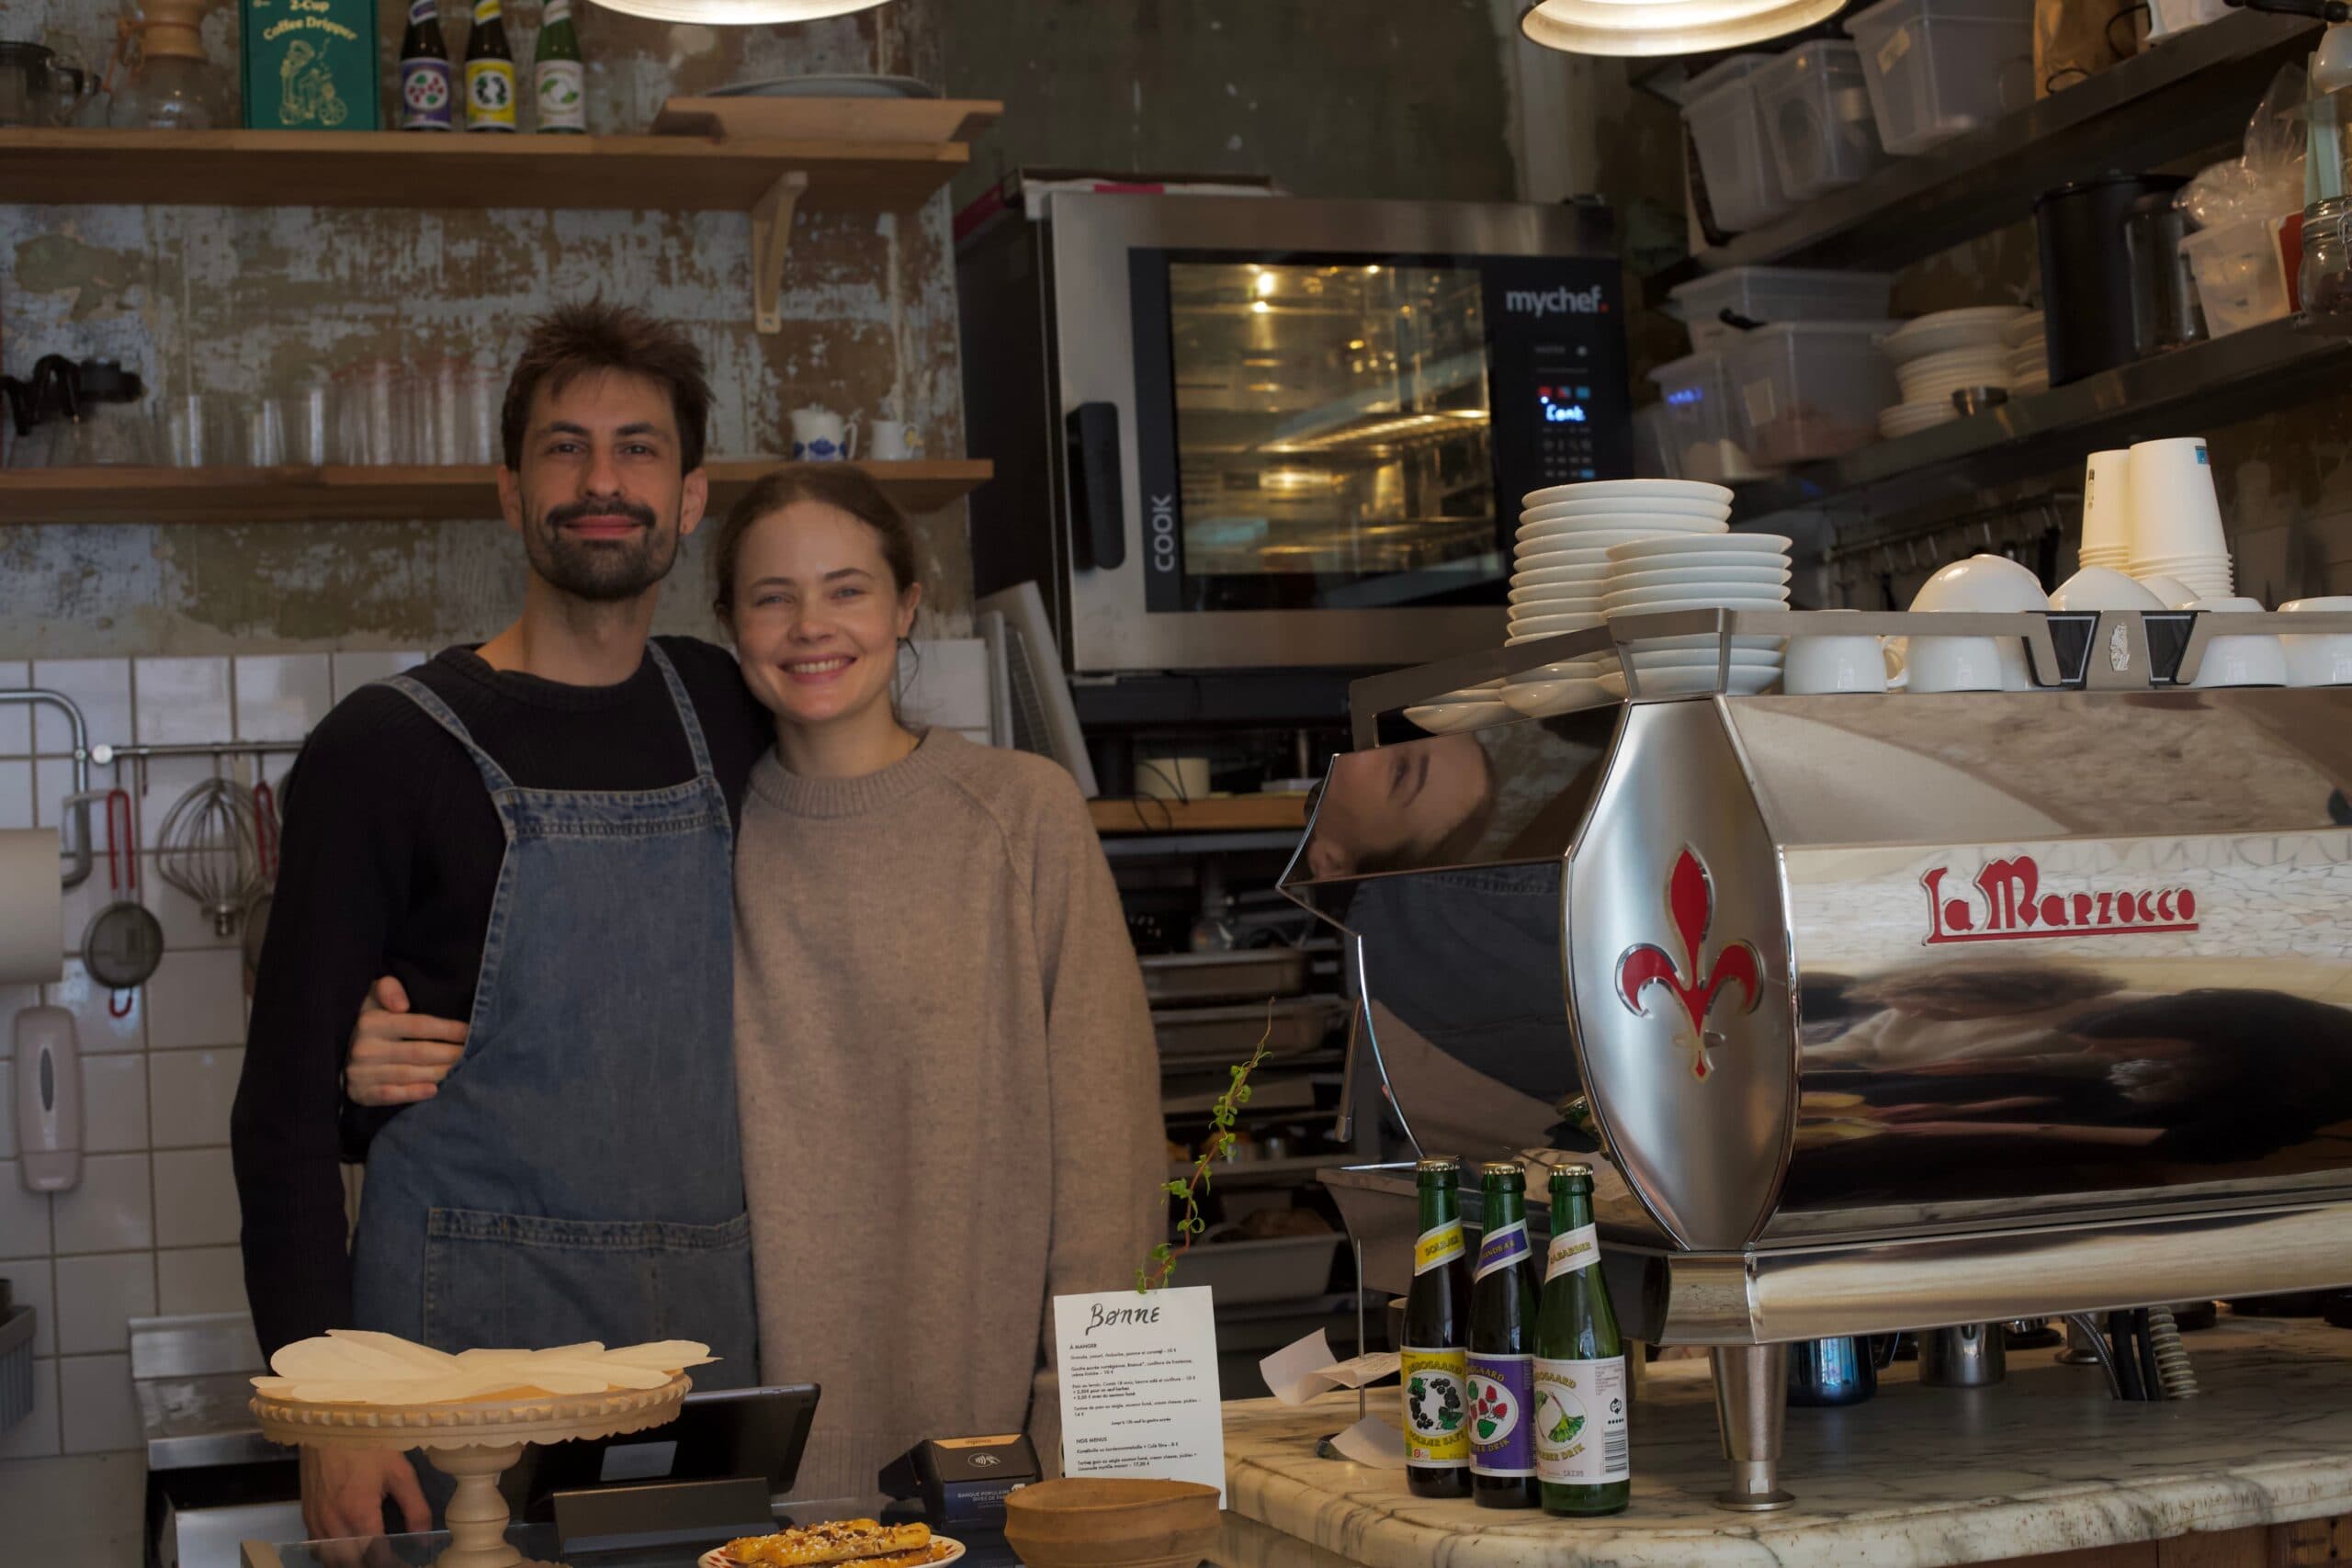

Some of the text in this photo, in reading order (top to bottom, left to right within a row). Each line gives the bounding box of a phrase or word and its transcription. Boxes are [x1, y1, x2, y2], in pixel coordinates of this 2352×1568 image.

[264, 16, 357, 40] Coffee Dripper
[1151, 493, 1175, 572] COOK
[1921, 855, 2197, 943] La Marzocco
